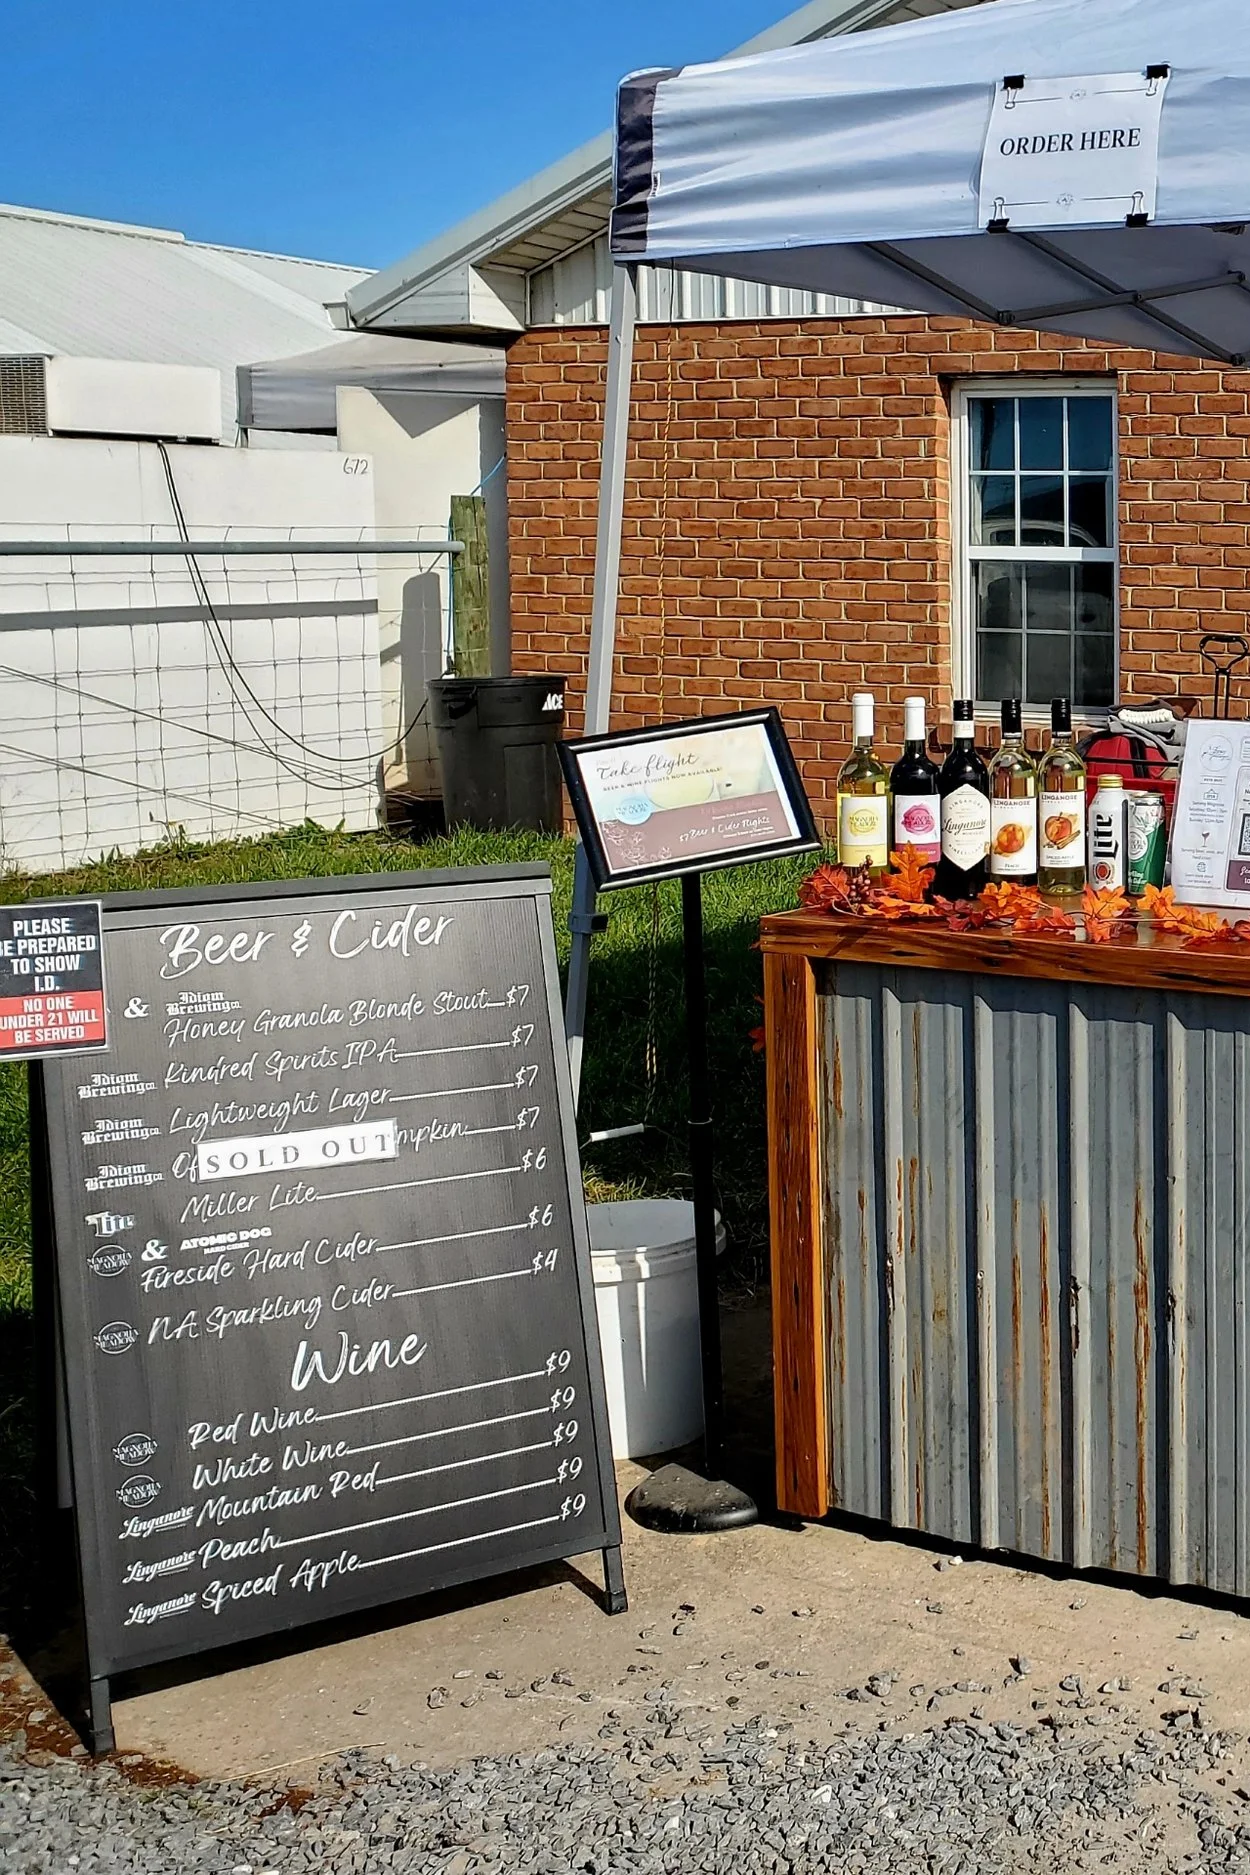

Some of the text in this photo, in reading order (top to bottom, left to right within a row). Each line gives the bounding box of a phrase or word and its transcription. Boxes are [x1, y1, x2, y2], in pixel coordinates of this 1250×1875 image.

[1000, 128, 1141, 156] ORDER HERE
[343, 457, 369, 475] 672
[542, 693, 564, 711] ACE
[596, 760, 642, 780] Take
[645, 753, 700, 777] flight
[13, 918, 71, 936] PLEASE
[17, 935, 97, 955] PREPARED
[159, 904, 455, 980] Beer & Cider
[10, 954, 81, 974] TO SHOW
[34, 975, 60, 992] I.D.
[23, 996, 74, 1013] NO ONE
[123, 996, 150, 1019] &
[165, 1001, 231, 1016] Brewing
[179, 991, 224, 1004] Idiom
[0, 1009, 99, 1030] UNDER 21 WILL
[164, 985, 530, 1048] Honey Granola Blonde Stout $7
[14, 1025, 84, 1044] BE SERVED
[165, 1024, 534, 1089] Kindred Spirits IPA $7
[77, 1082, 146, 1099] Brewing
[91, 1073, 139, 1087] Idiom
[169, 1065, 539, 1145] Lightweight Lager $7
[95, 1118, 143, 1133] Idiom
[516, 1106, 540, 1131] $7
[81, 1128, 150, 1145] Brewing
[207, 1134, 391, 1174] SOLD OUT
[84, 1173, 153, 1192] Brewing
[98, 1164, 147, 1179] Idiom
[180, 1147, 547, 1223] Miller Lite $6
[140, 1204, 553, 1293] Fireside Hard Cider $6
[140, 1239, 168, 1261] &
[180, 1226, 272, 1251] ATOMIC DOG
[148, 1249, 558, 1345] NA Sparkling Cider $4
[291, 1331, 427, 1391] Wine
[188, 1350, 571, 1449] Red Wine $9
[192, 1386, 576, 1490] White Wine $9
[118, 1420, 579, 1539] Linganore Mountain Red $9
[122, 1457, 583, 1584] Linganore Peach $9
[124, 1493, 586, 1626] Linganore Spiced Apple $9
